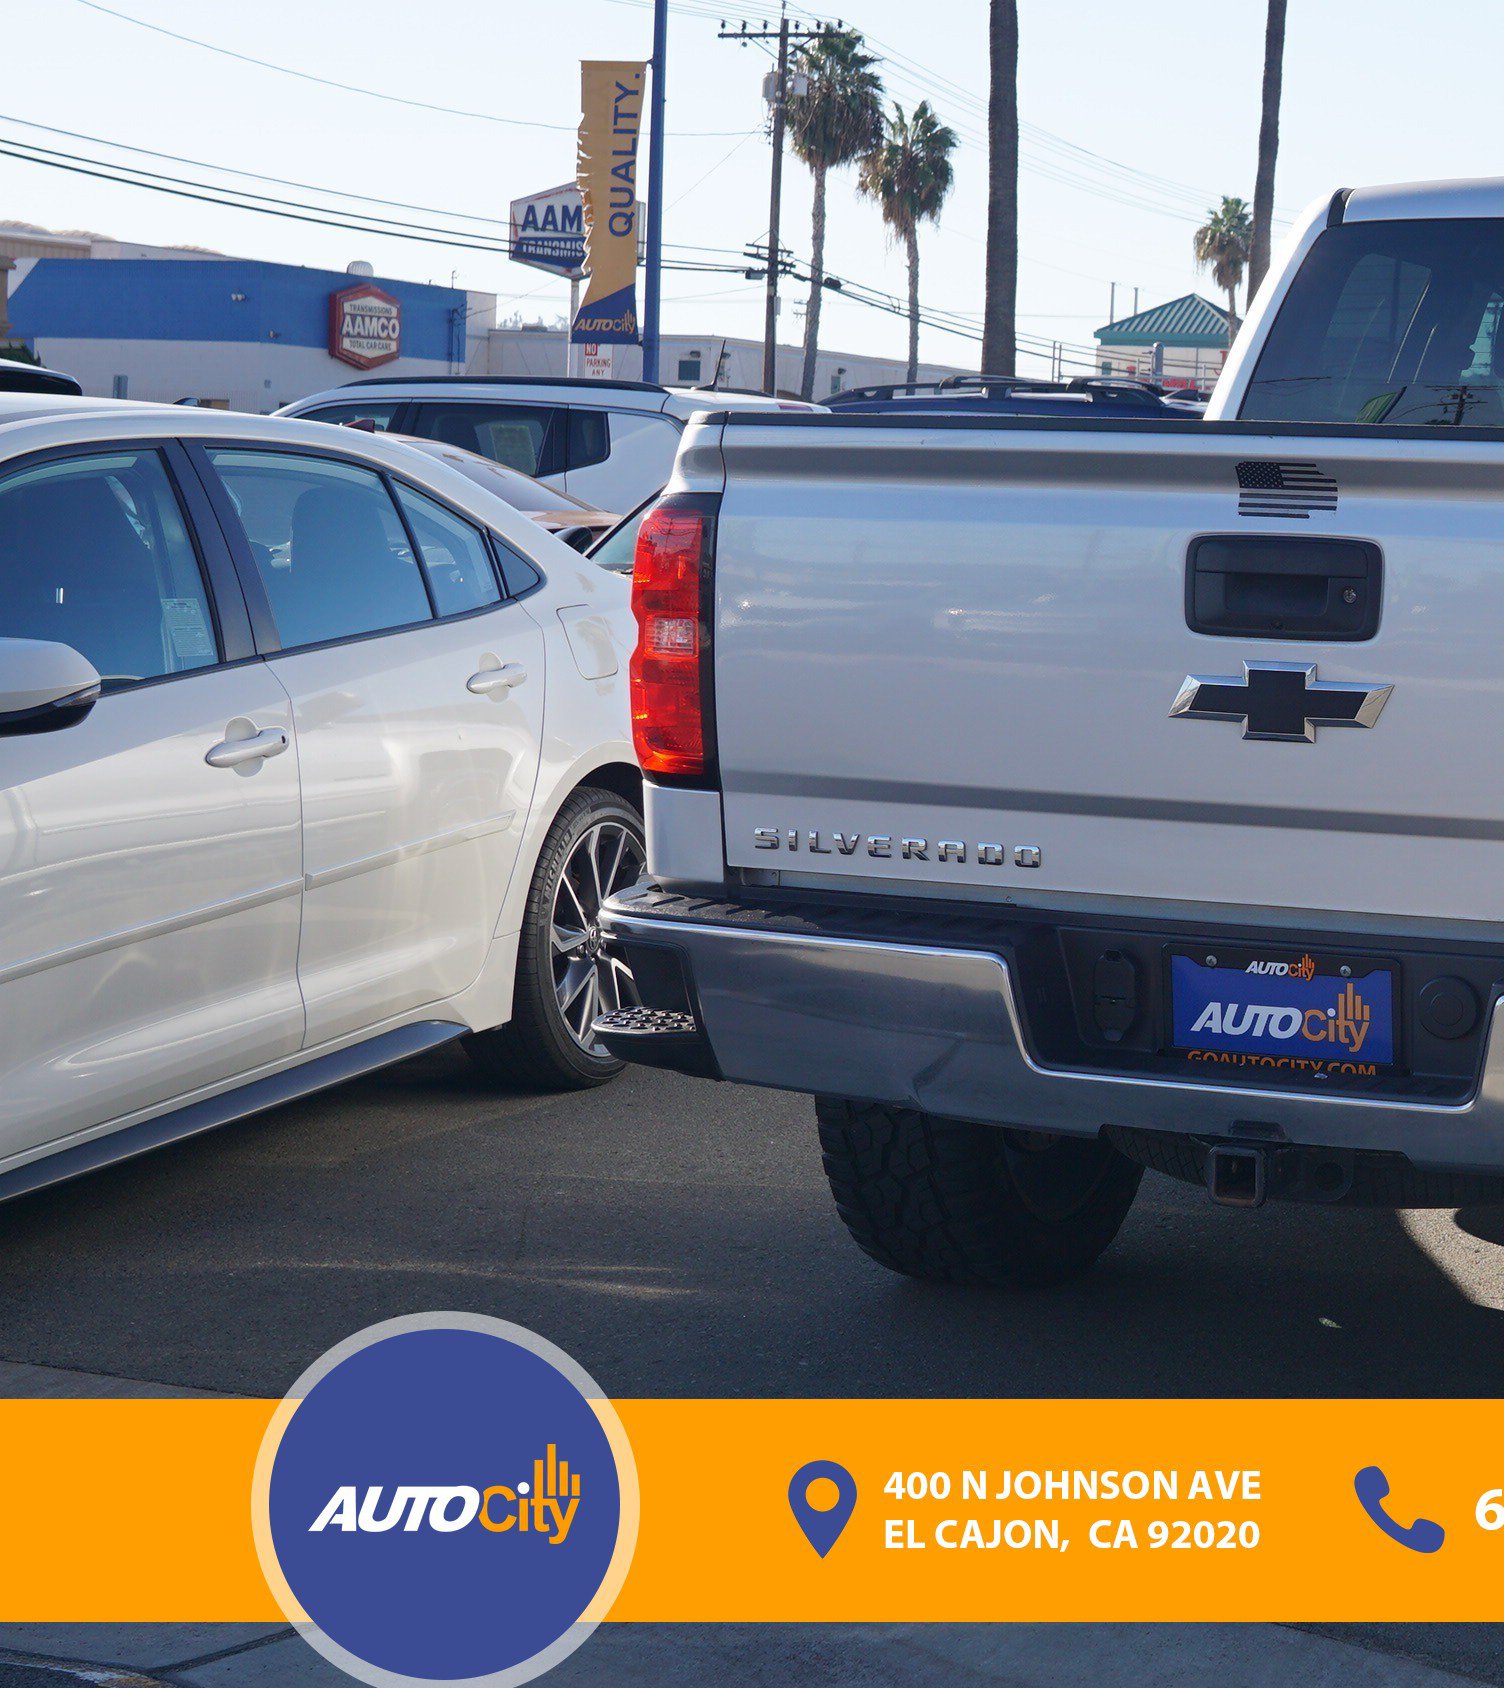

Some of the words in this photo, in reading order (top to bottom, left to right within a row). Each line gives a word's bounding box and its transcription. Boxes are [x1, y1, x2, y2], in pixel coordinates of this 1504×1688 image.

[608, 73, 641, 238] QUALITY.
[349, 303, 393, 315] TRANSMISSIONS
[341, 314, 400, 340] AAMCO
[349, 339, 365, 349] TOTAL
[366, 341, 377, 350] CAR
[586, 343, 597, 355] NO
[586, 357, 611, 368] PARKING
[754, 826, 1042, 868] SILVERADO
[1245, 955, 1315, 981] AUTOCity
[1190, 989, 1370, 1053] AUTOCity
